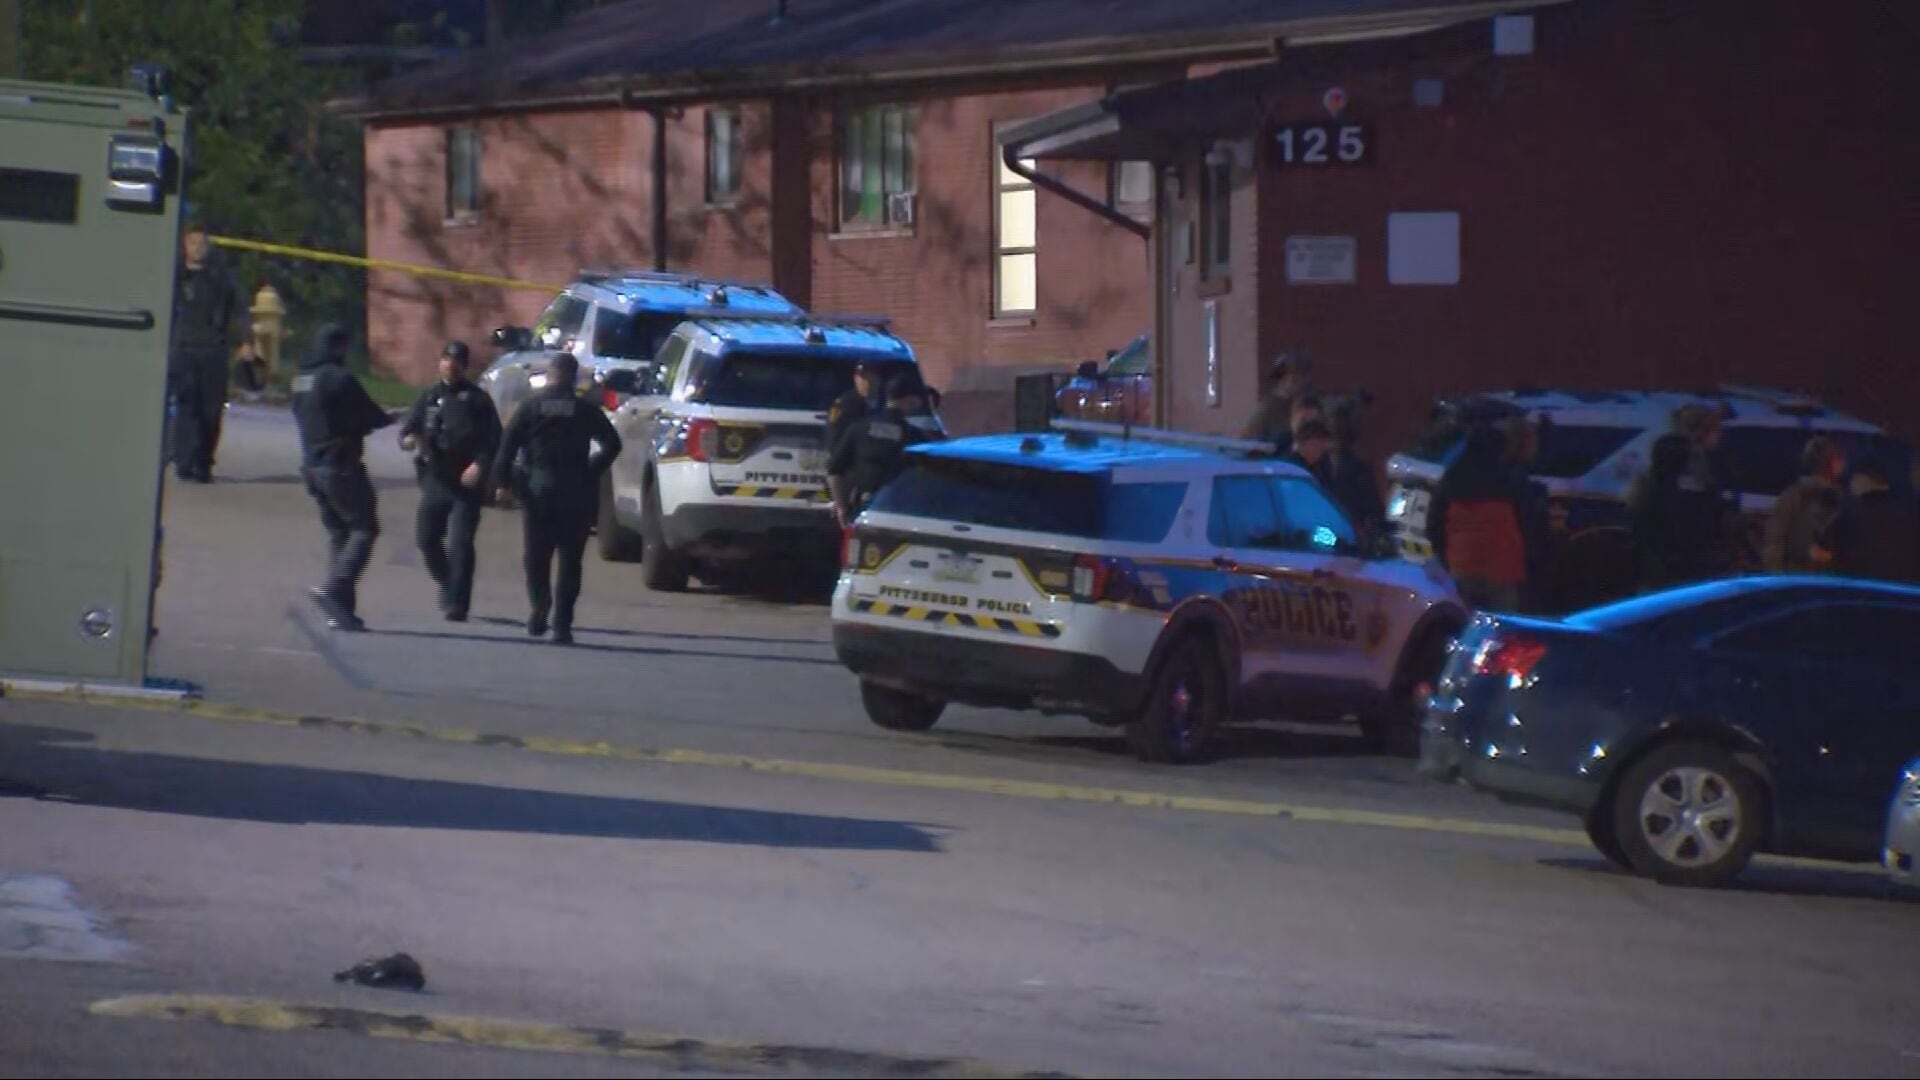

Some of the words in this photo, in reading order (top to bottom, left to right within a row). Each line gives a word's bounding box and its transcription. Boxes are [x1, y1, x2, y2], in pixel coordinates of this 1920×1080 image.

[1276, 126, 1364, 162] 125
[744, 471, 827, 484] PITTSBUR
[879, 584, 969, 608] PITTSBURGH
[976, 598, 1032, 615] POLICE
[1236, 585, 1356, 641] POLICE
